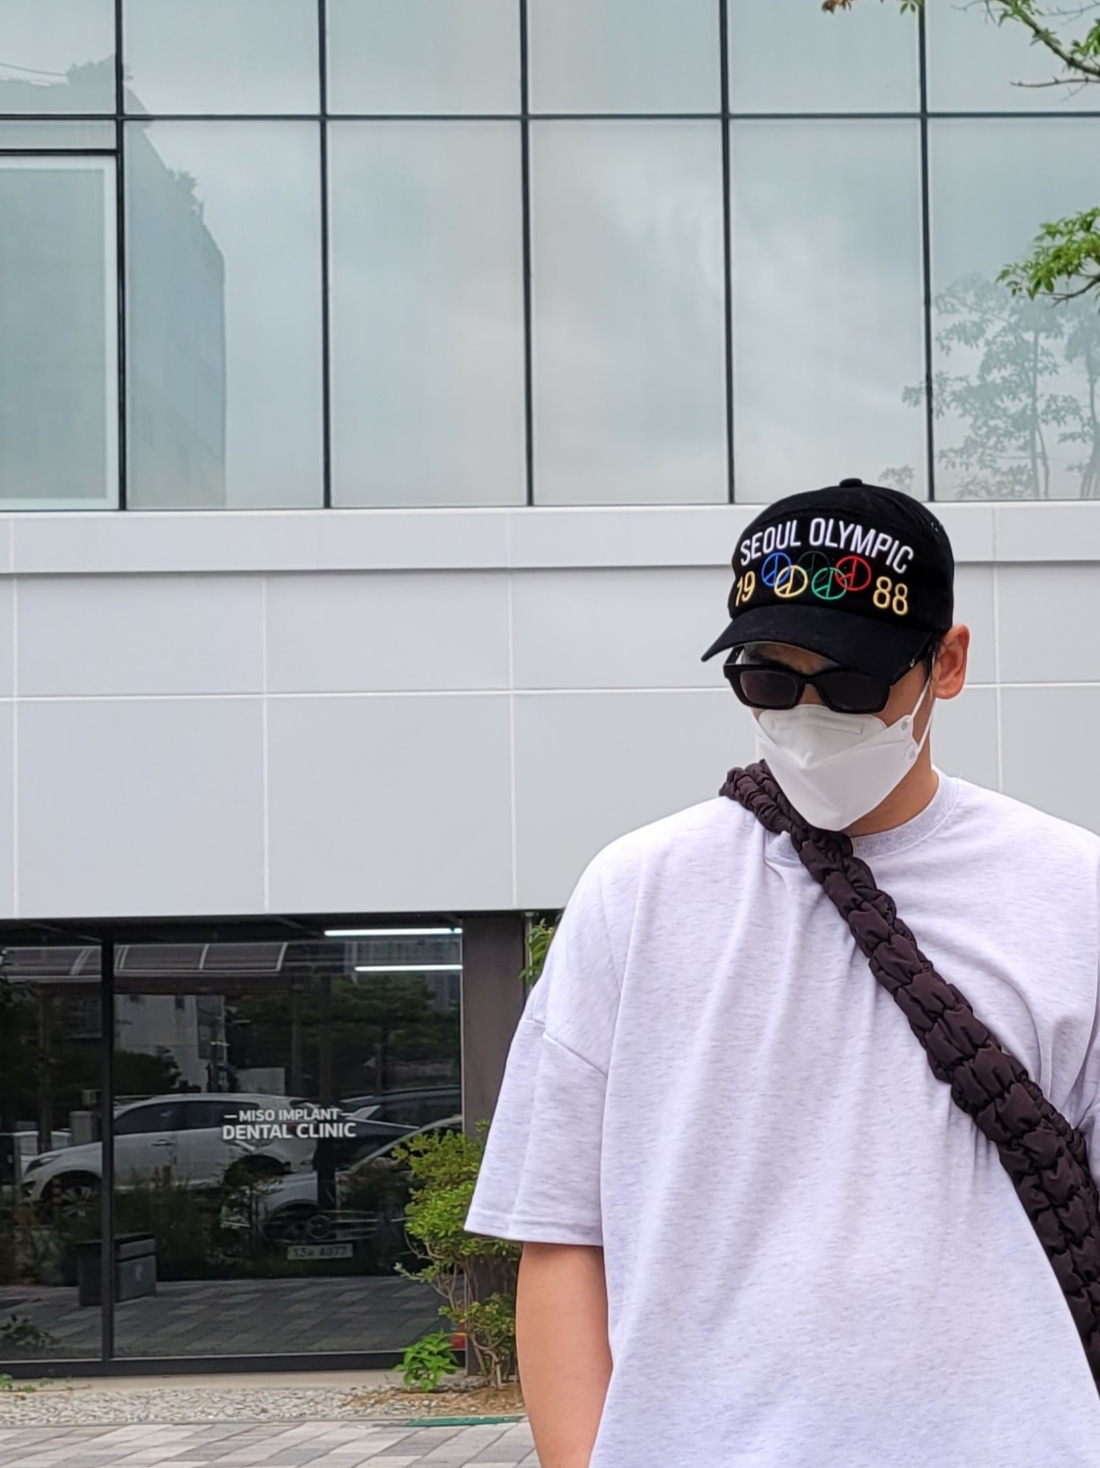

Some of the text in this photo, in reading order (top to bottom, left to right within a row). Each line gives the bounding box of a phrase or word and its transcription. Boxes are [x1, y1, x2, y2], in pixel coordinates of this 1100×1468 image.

[740, 517, 914, 574] SEOUL OLYMPIC
[735, 570, 909, 616] 19 88
[222, 1122, 357, 1140] DENTAL CLINIC
[238, 1108, 340, 1122] MISO IMPLANT
